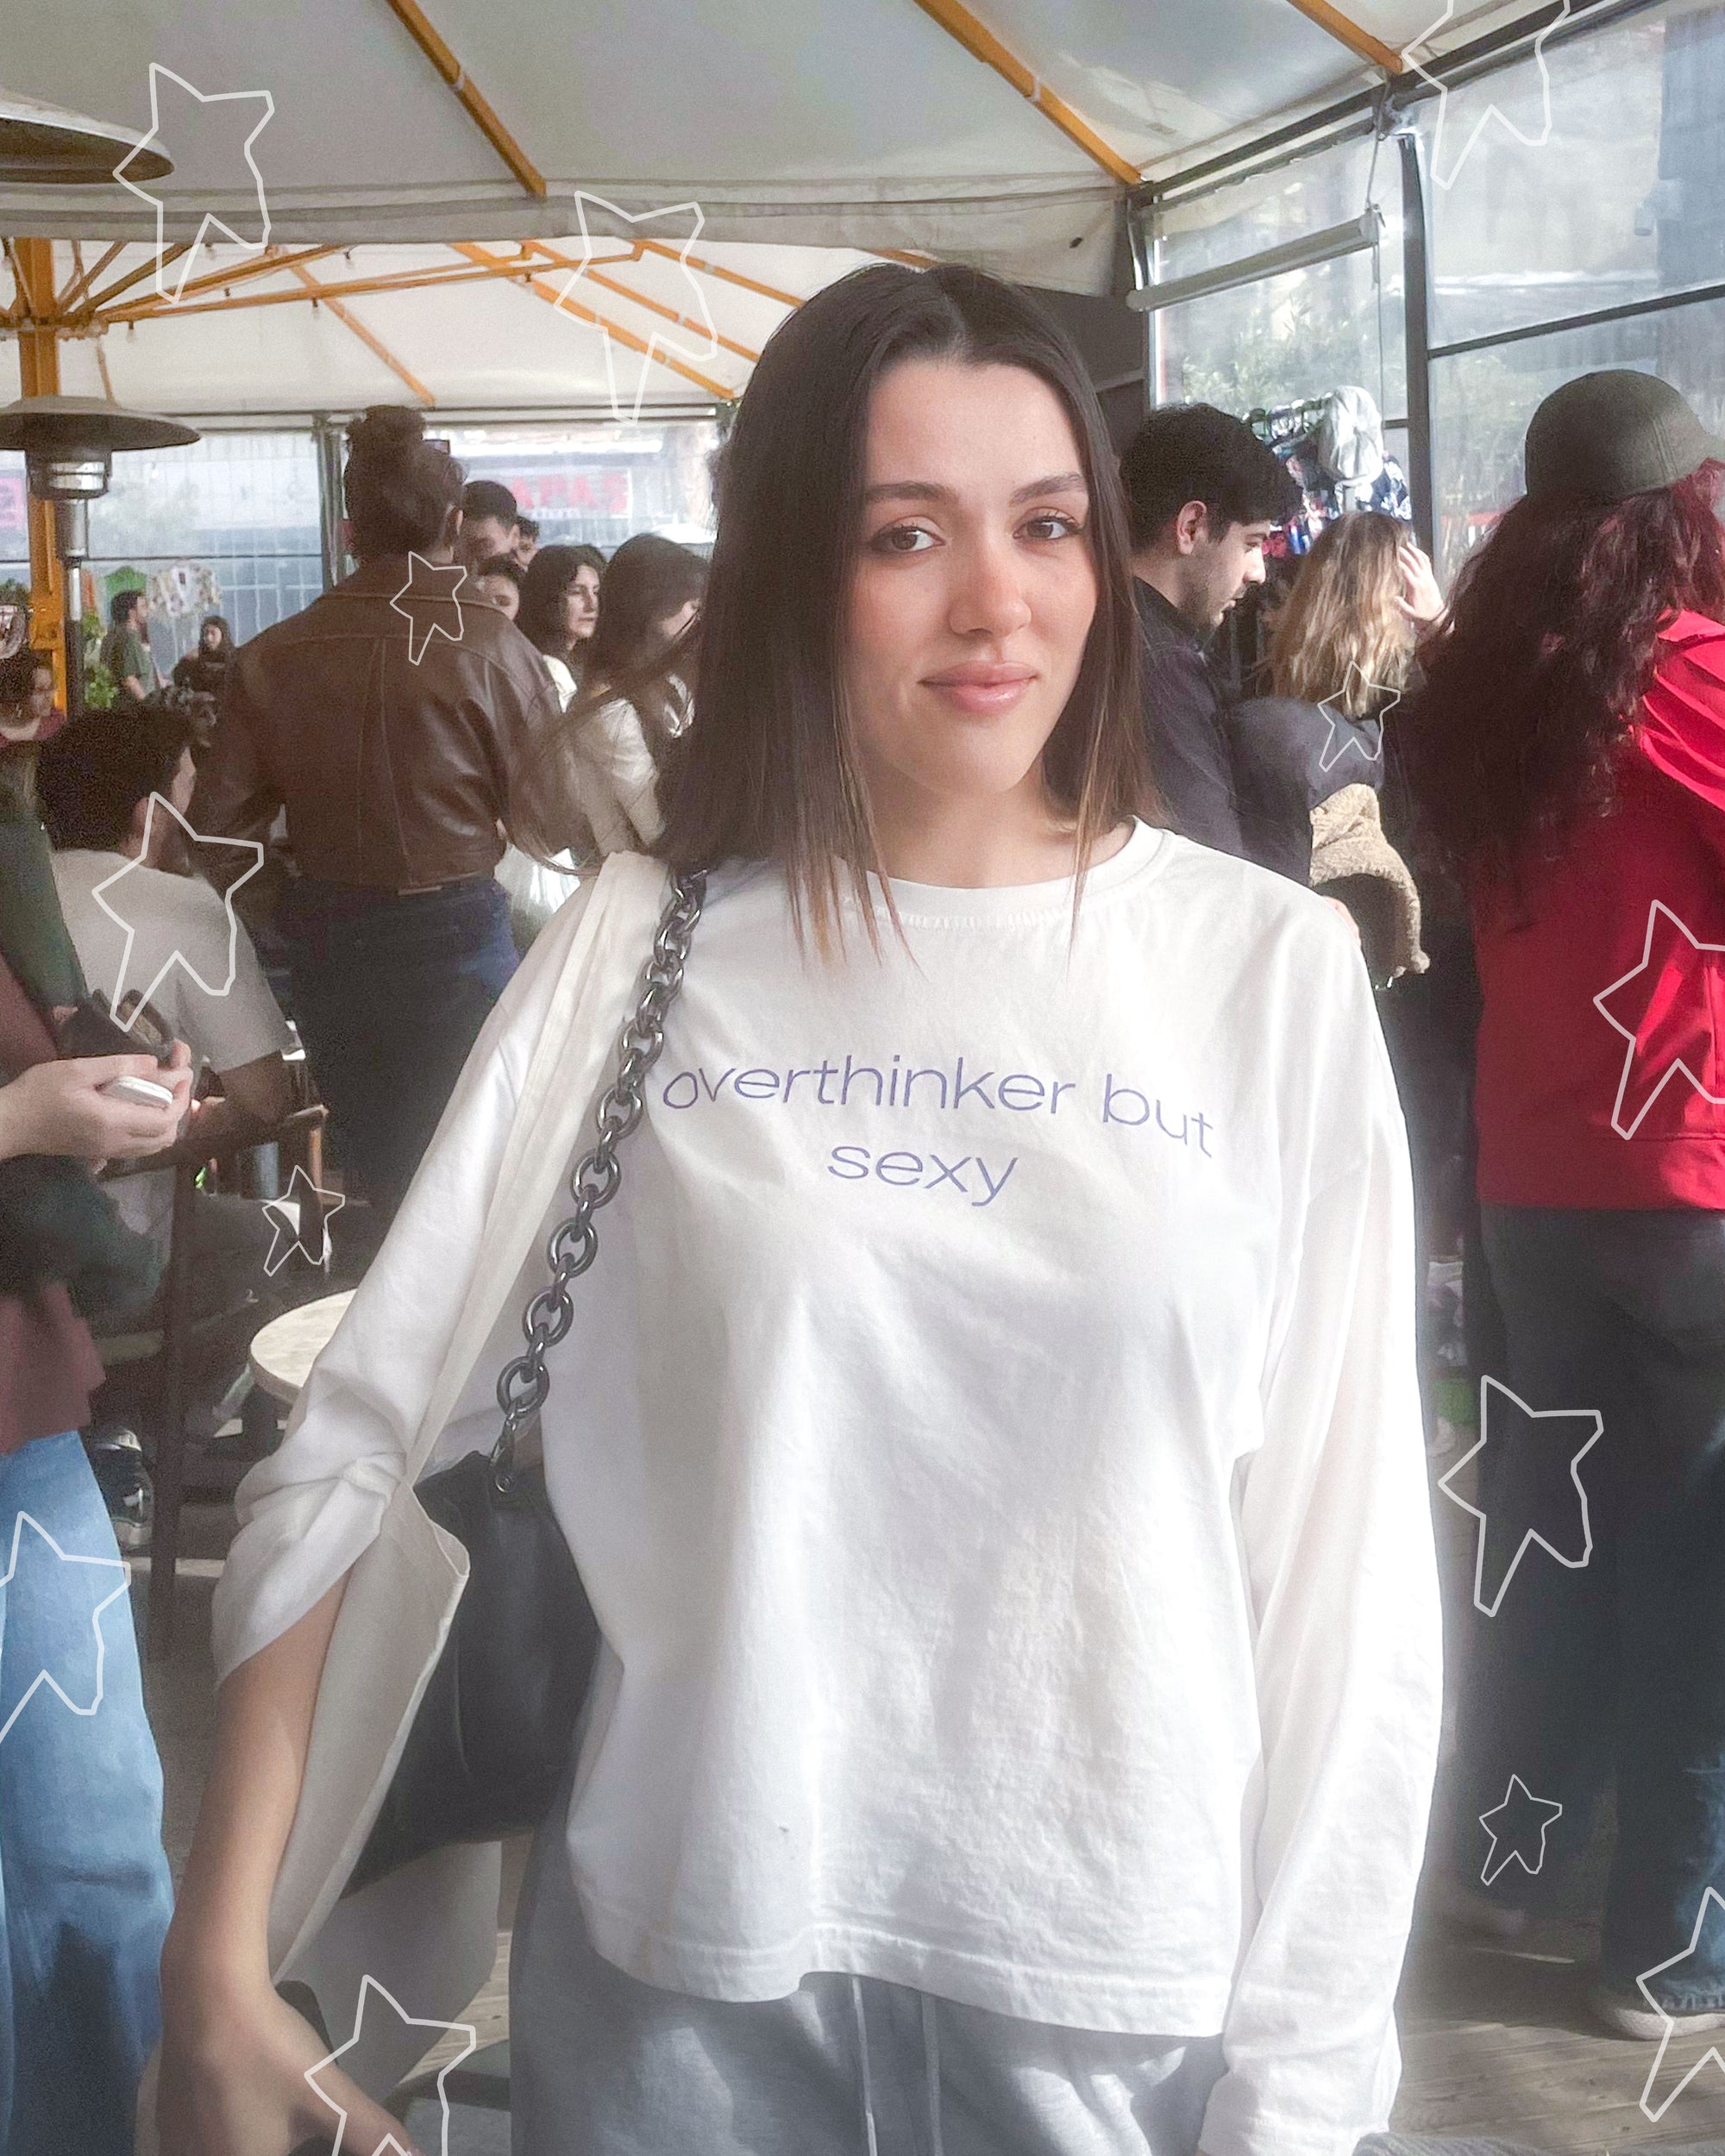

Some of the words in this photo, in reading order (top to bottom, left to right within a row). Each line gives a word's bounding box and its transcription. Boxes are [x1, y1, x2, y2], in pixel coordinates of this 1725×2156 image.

[662, 1055, 1076, 1115] overthinker
[1102, 1074, 1214, 1158] but
[827, 1145, 1019, 1207] sexy
